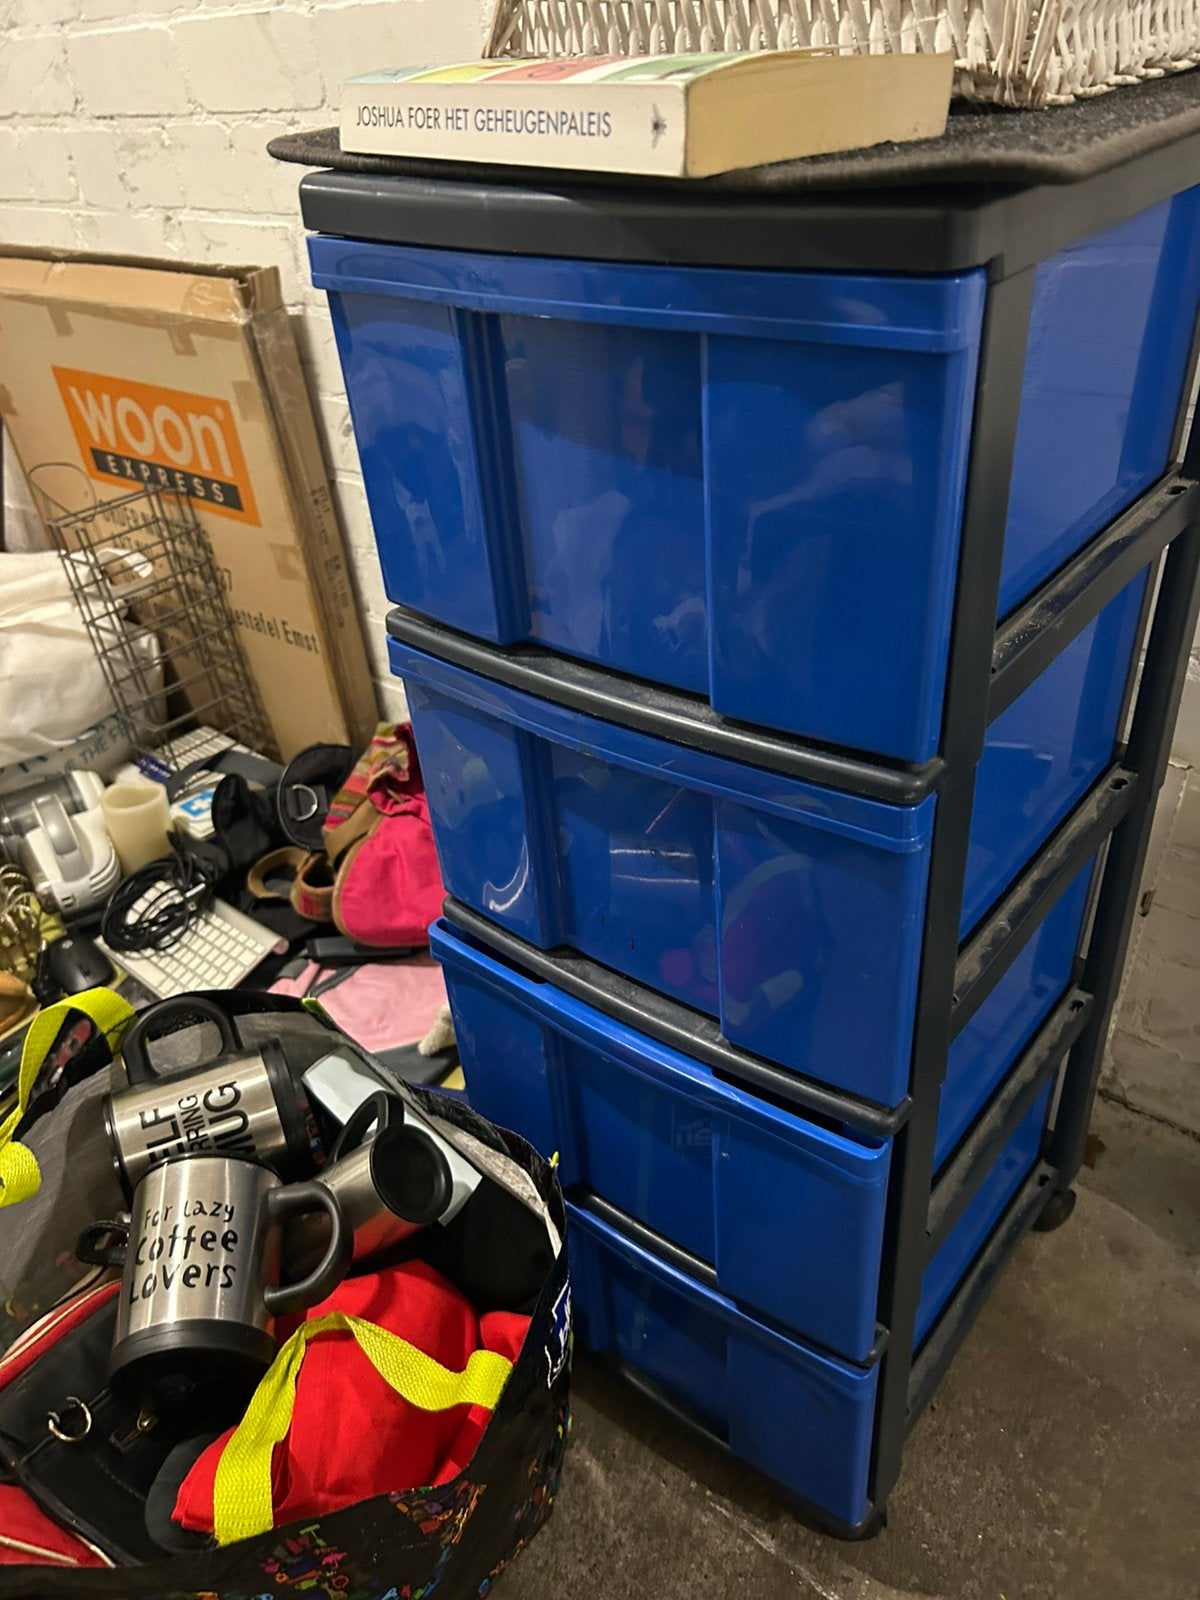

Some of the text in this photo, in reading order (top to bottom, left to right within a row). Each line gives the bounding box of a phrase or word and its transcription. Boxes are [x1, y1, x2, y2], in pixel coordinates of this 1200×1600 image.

[356, 105, 612, 137] JOSHUA FOER HET GEHEUGENPALEIS
[106, 454, 225, 503] EXPRESS
